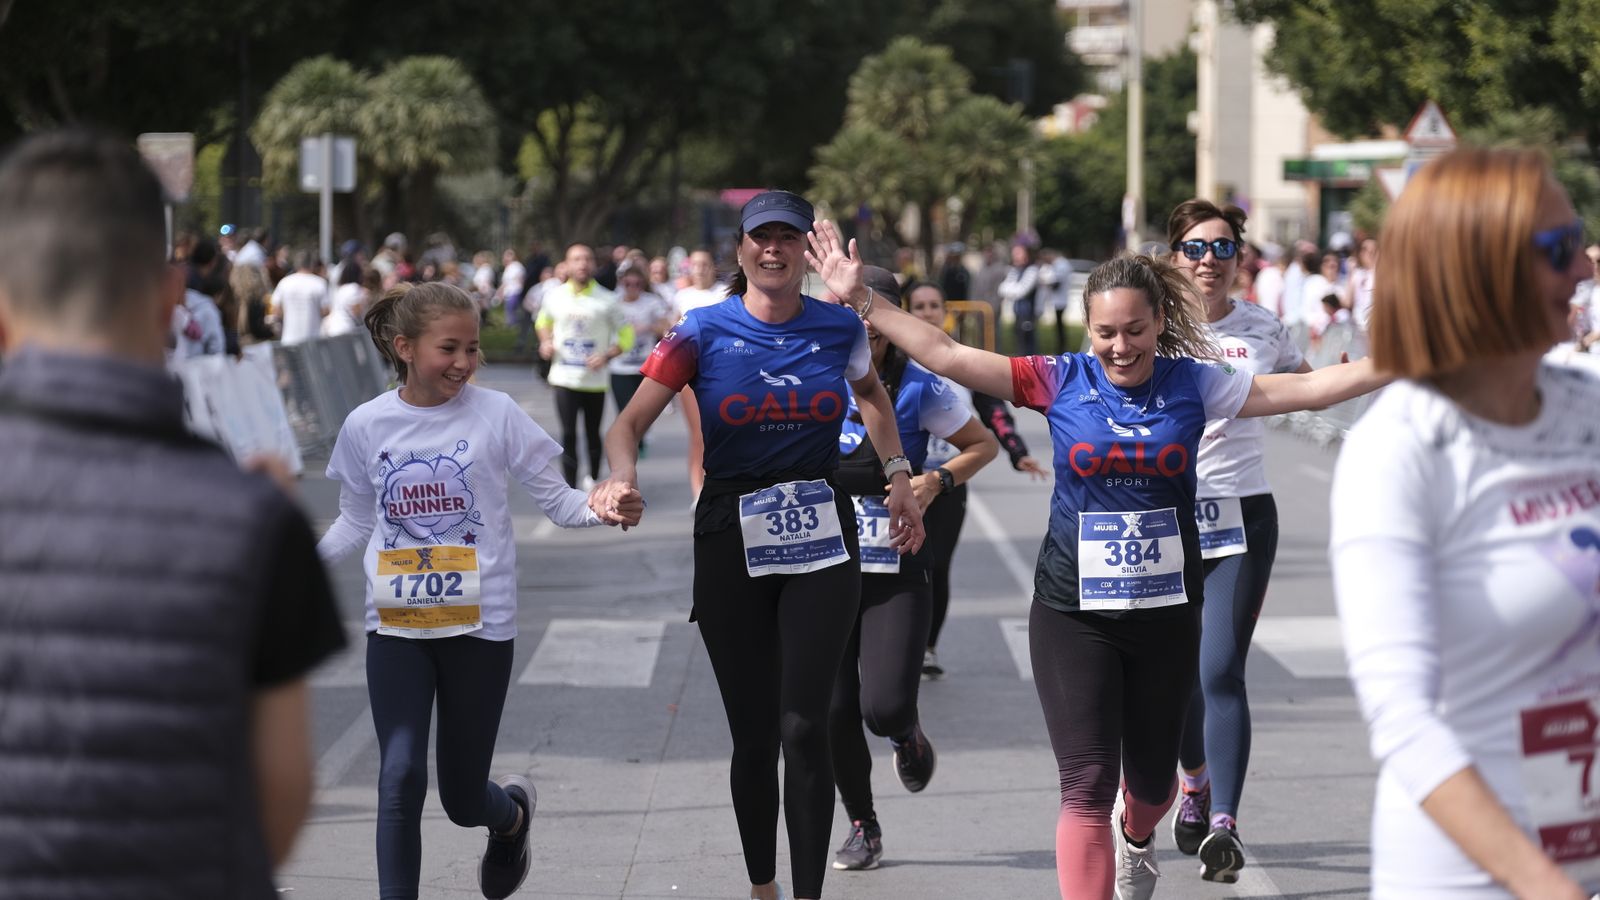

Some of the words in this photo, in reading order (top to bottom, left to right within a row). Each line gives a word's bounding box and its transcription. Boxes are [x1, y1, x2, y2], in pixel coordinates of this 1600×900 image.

[723, 346, 755, 355] SPIRAL
[719, 389, 842, 426] GALO
[759, 423, 803, 432] SPORT
[1068, 441, 1188, 478] GALO
[1106, 478, 1151, 487] SPORT
[402, 482, 446, 500] MINI
[389, 497, 467, 517] RUNNER
[753, 496, 777, 506] MUJER
[765, 506, 819, 536] 383
[780, 531, 811, 542] NATALIA
[1104, 539, 1162, 567] 384
[1121, 566, 1148, 574] SILVIA
[389, 572, 463, 598] 1702
[406, 597, 445, 605] DANIELLA
